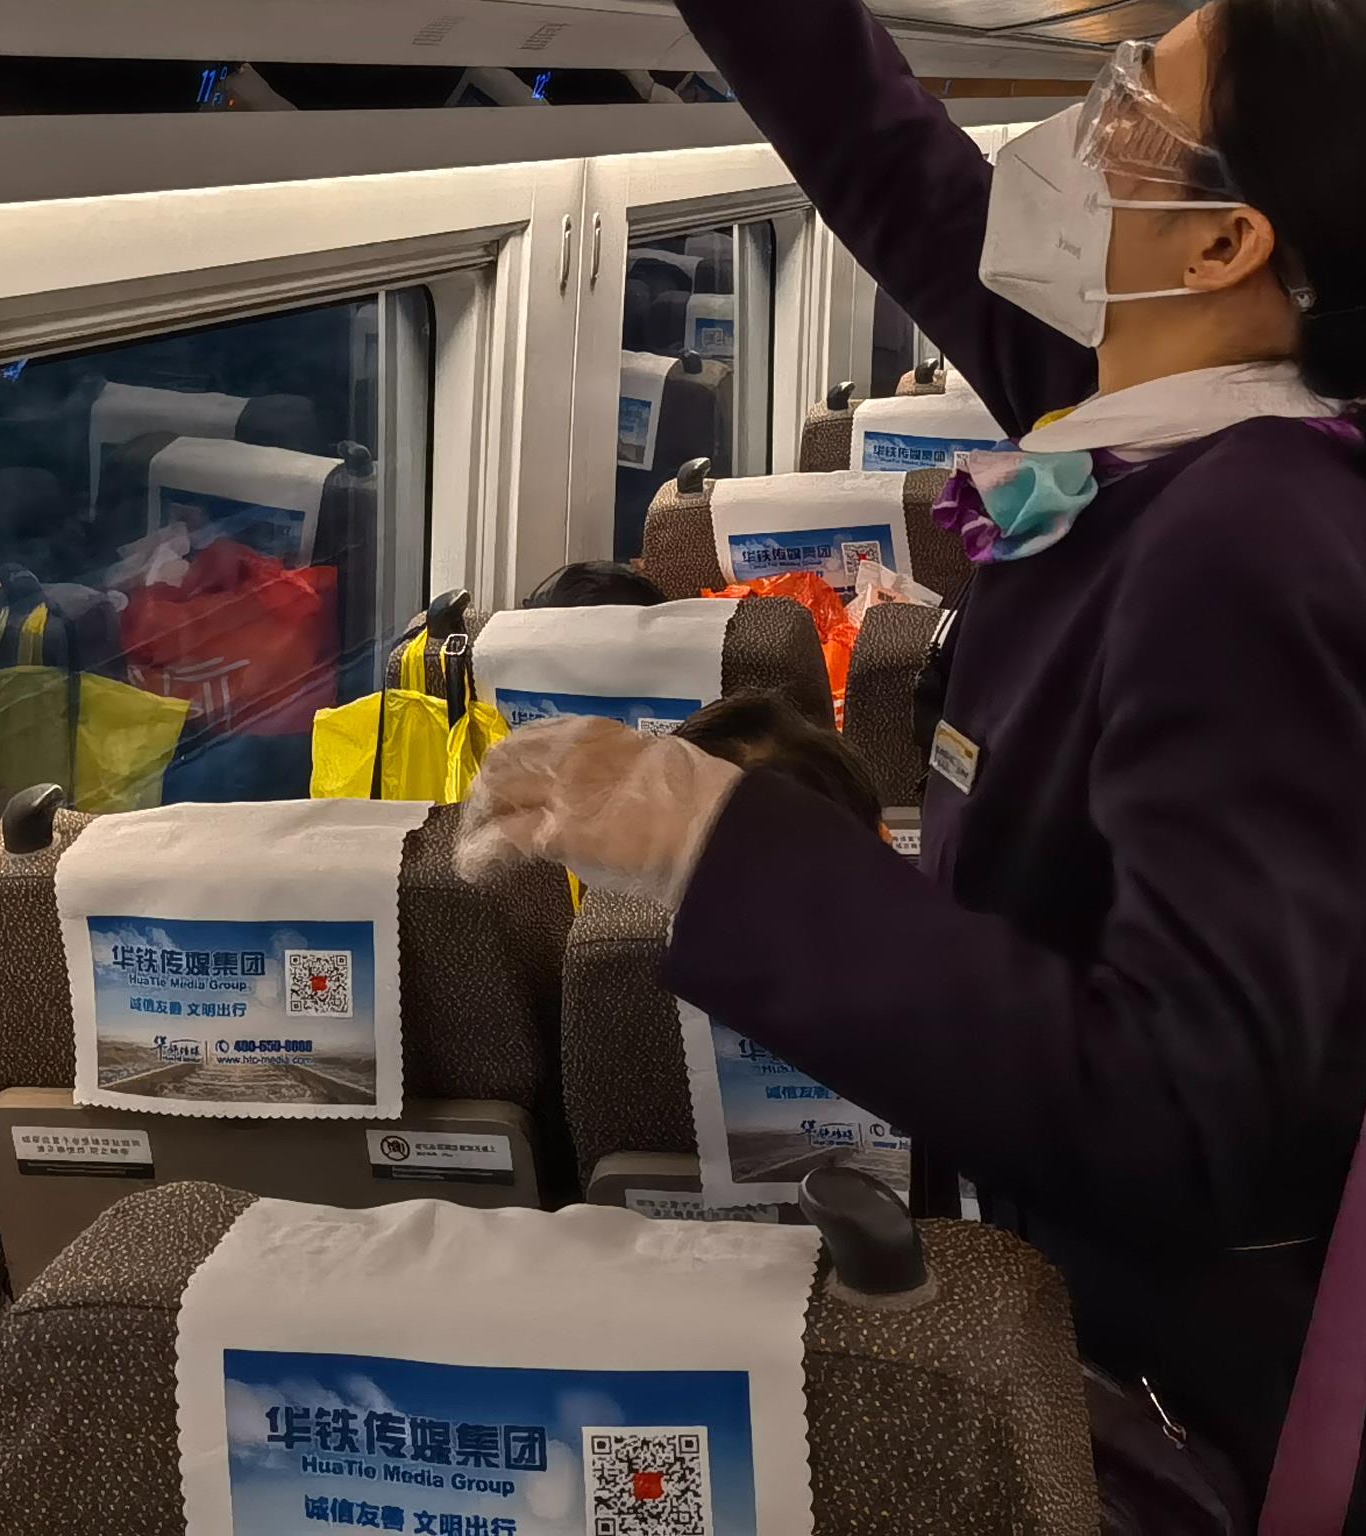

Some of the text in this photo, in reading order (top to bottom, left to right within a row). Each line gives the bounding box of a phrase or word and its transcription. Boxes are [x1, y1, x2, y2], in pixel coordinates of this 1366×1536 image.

[112, 945, 265, 976] 华铁传媒集团
[209, 979, 248, 992] Group
[186, 1002, 247, 1017] 文明出行
[265, 1406, 548, 1473] 华铁传媒集团
[301, 1455, 516, 1498] HuaTie Media Group
